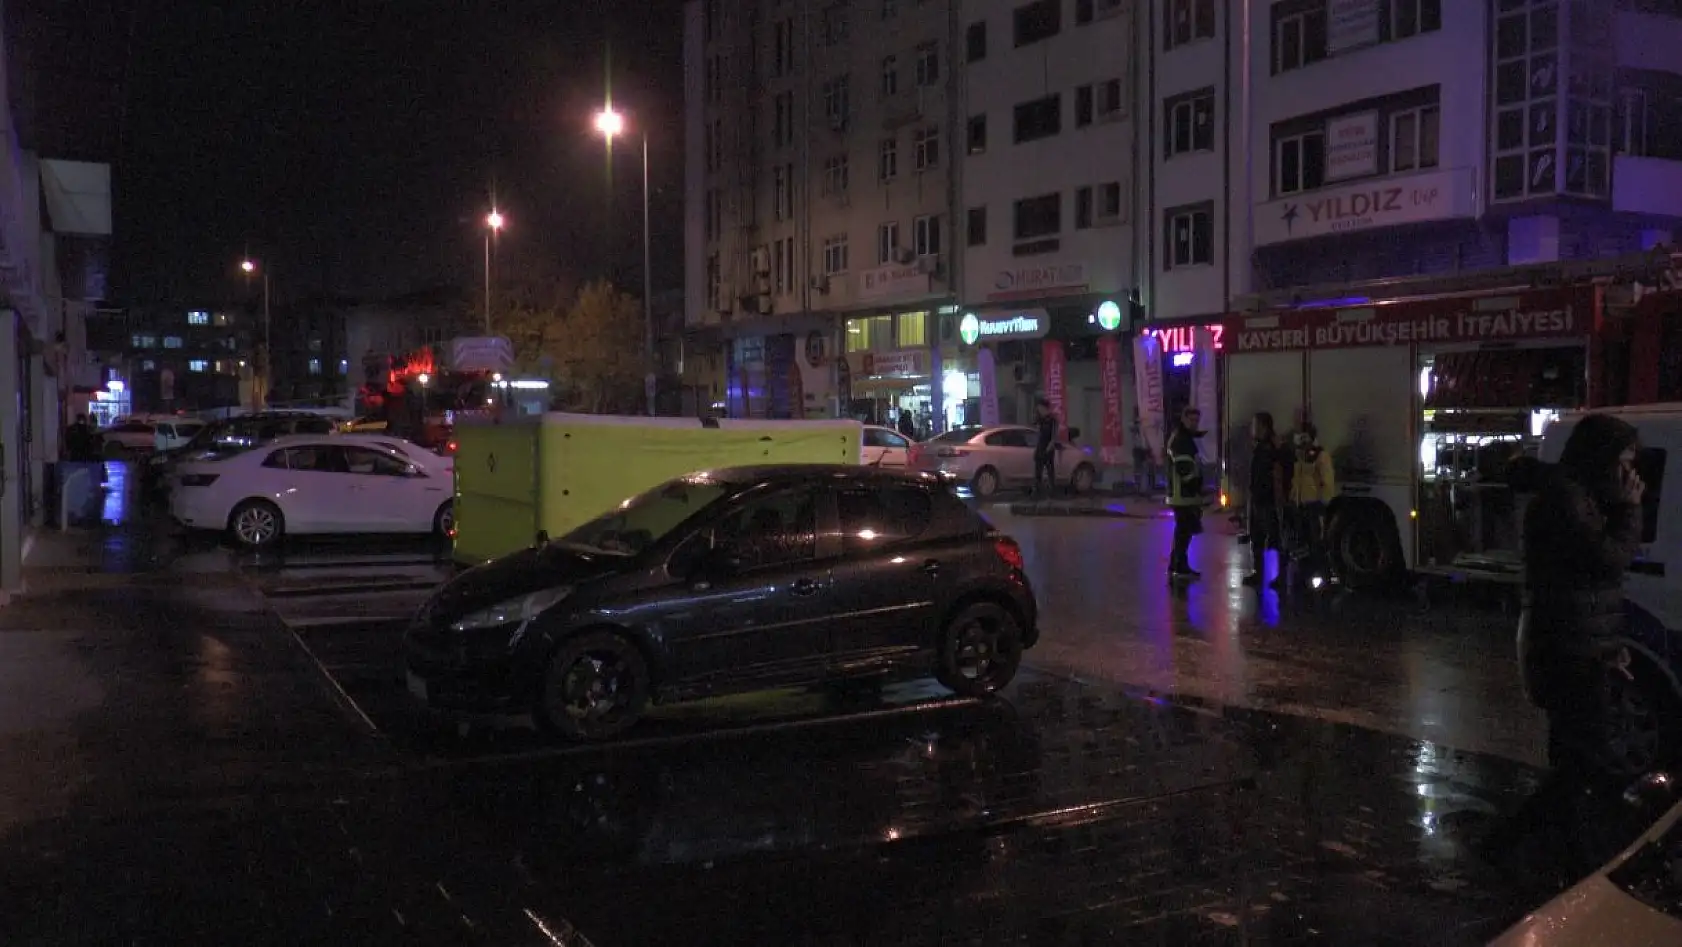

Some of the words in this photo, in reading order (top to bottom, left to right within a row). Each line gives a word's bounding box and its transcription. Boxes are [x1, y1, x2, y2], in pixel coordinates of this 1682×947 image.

[1305, 187, 1403, 222] YILDIZ
[1238, 324, 1309, 350] KAYSERİ
[1316, 314, 1450, 346] BÜYÜKŞEHİR
[1457, 304, 1574, 337] İTFAİYESİ
